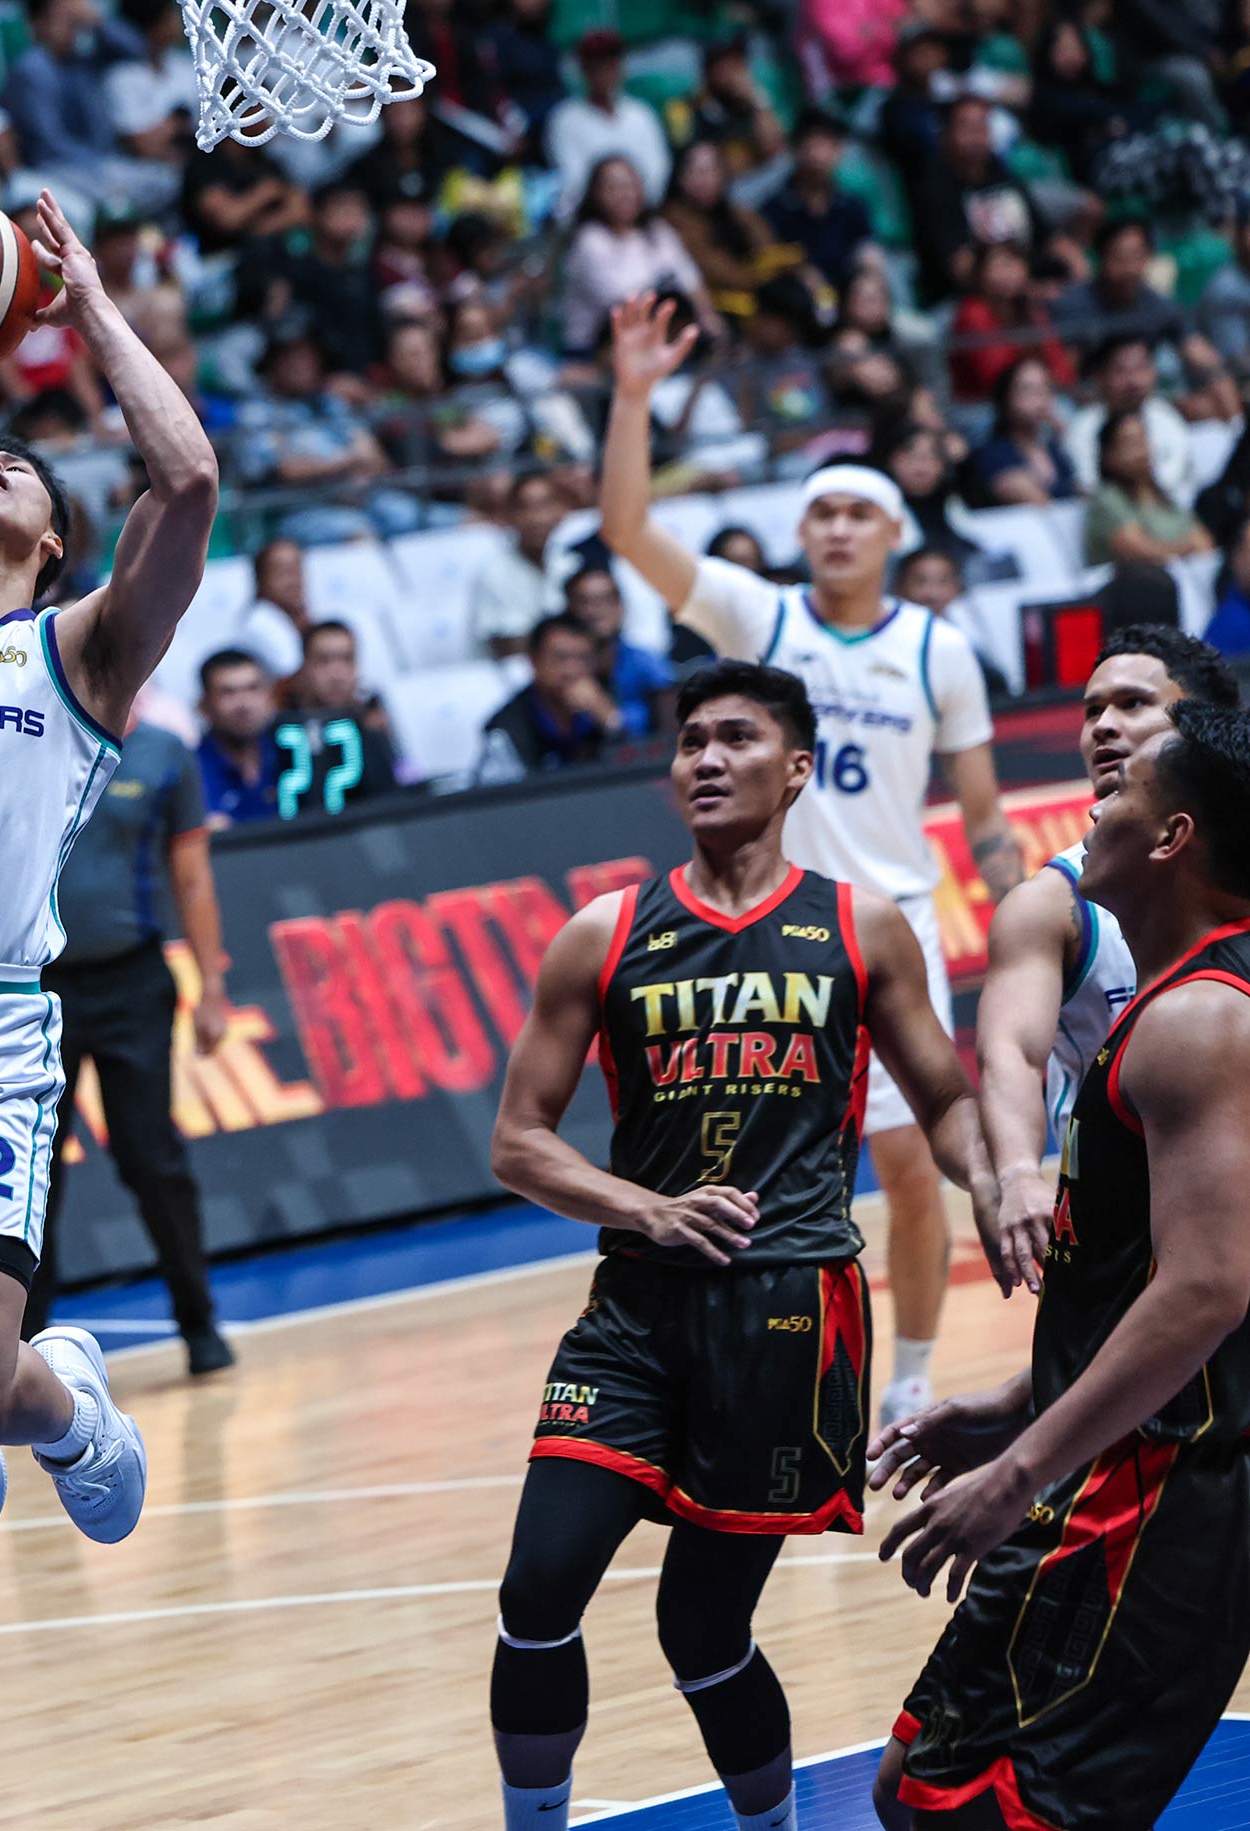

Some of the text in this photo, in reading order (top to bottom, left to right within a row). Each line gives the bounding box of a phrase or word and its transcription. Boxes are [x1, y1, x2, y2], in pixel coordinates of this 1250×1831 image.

[630, 971, 835, 1037] TITAN
[645, 1031, 821, 1087] ULTRA
[654, 1083, 802, 1102] GIANT RISERS
[701, 1111, 741, 1183] 5
[540, 1403, 589, 1424] LTRA
[768, 1447, 801, 1504] 5
